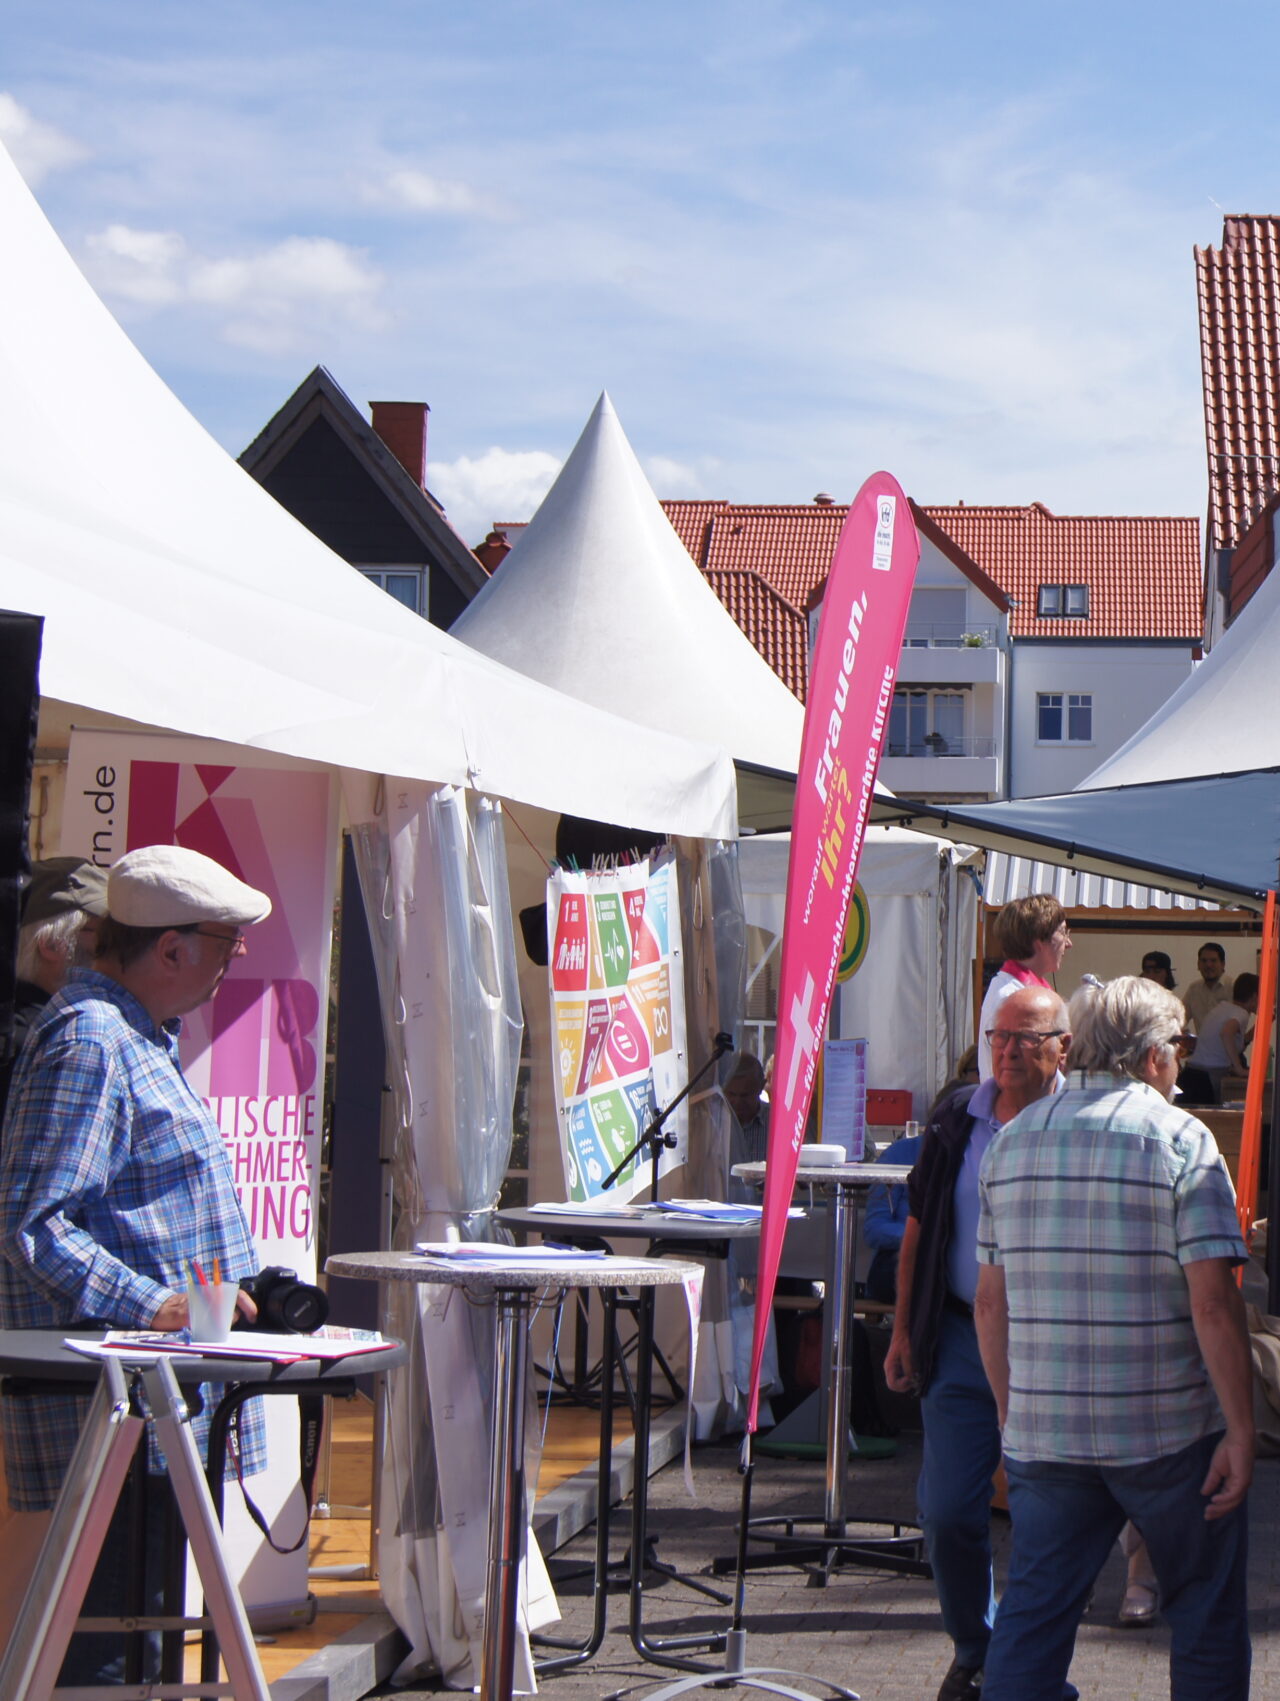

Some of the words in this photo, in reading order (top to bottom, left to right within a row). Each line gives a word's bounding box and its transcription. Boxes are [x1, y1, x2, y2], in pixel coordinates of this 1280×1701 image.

[814, 590, 868, 806] Frauen,
[83, 764, 116, 868] rn.de
[821, 766, 852, 891] Ihr?
[803, 836, 825, 925] worauf
[804, 1056, 816, 1091] für
[813, 1000, 828, 1052] eine
[202, 1095, 316, 1138] LISCHE
[236, 1183, 312, 1241] UNG
[304, 1420, 317, 1468] Canon
